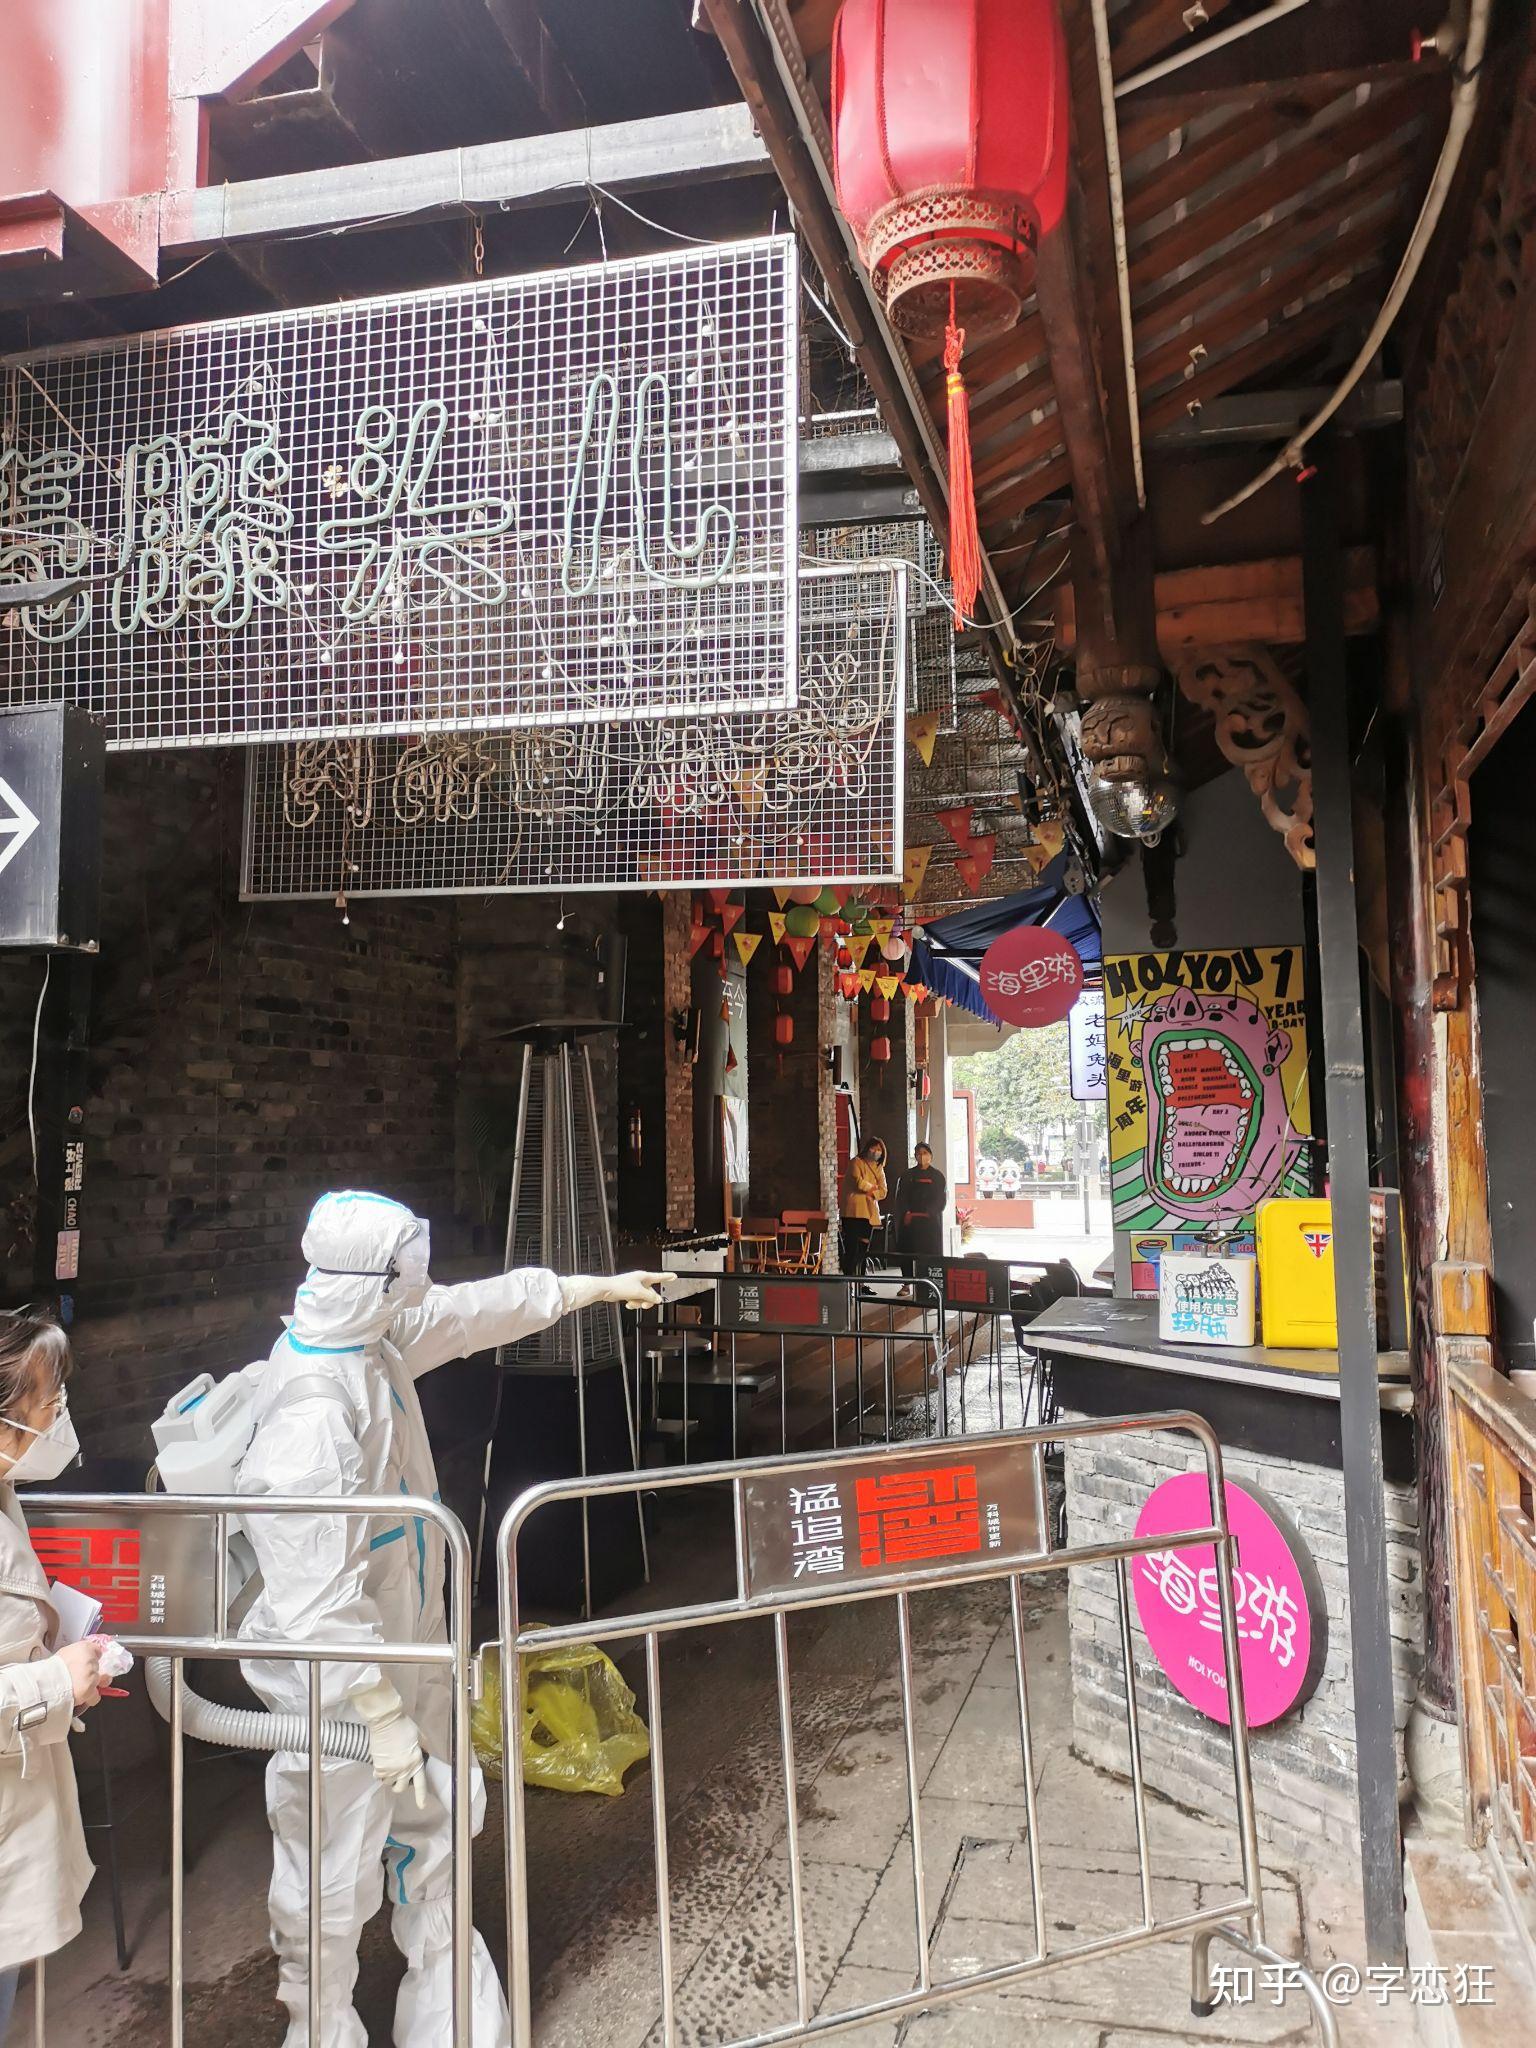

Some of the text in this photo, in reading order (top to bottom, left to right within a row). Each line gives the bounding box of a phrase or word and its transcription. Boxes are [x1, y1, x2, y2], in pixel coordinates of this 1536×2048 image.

[1105, 947, 1294, 998] HOLYOU 1
[1265, 1000, 1305, 1019] YEAR
[1271, 1017, 1305, 1029] B-DAY
[1085, 1013, 1106, 1088] 老妈兔头
[738, 1285, 760, 1322] 猛追湾
[1177, 1301, 1237, 1316] 使用充电宝
[788, 1482, 845, 1580] 猛追湾
[985, 1503, 1001, 1548] 万科城市更新
[149, 1574, 166, 1624] 万科城市更新
